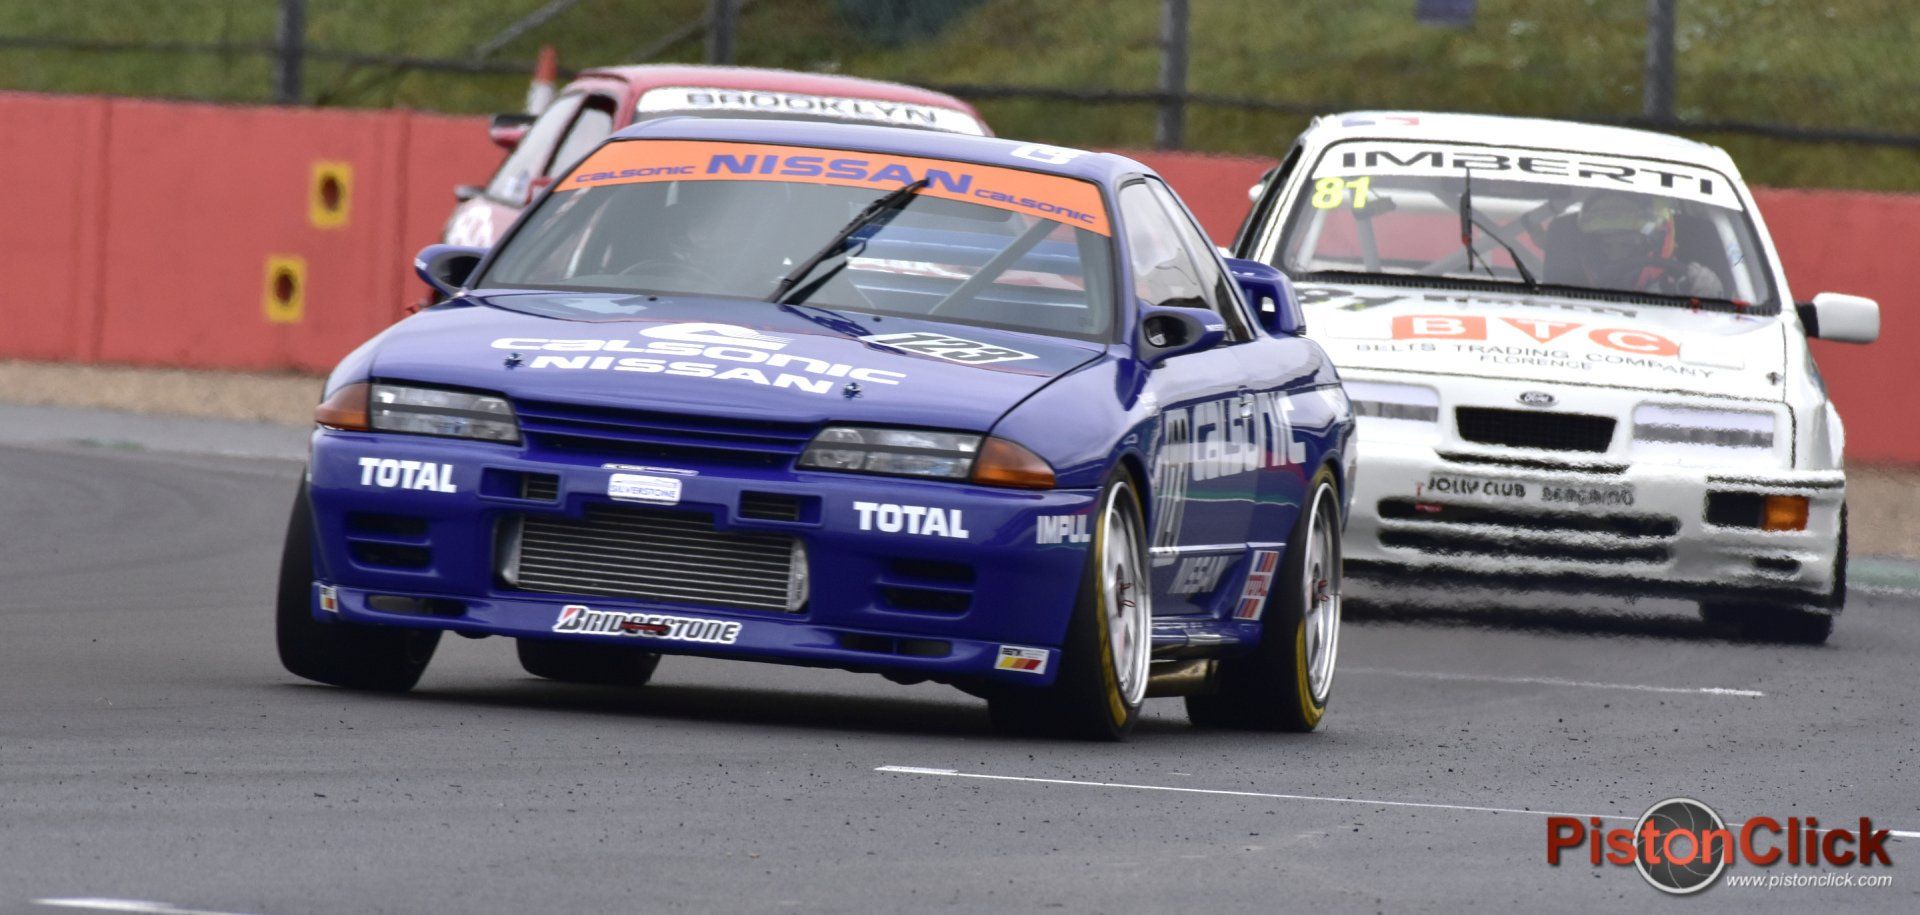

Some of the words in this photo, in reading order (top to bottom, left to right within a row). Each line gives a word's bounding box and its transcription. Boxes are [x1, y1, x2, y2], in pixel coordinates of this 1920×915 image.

[687, 93, 938, 123] BROOKLYN
[706, 154, 973, 195] NISSAN
[1342, 151, 1713, 196] IMBERTI
[1311, 175, 1371, 210] 81
[876, 334, 1024, 363] 123
[1455, 344, 1569, 359] TRADING
[1585, 353, 1714, 379] COMPANY
[1480, 354, 1593, 370] FLORENCE
[529, 354, 833, 394] NISSAN
[359, 457, 457, 493] TOTAL
[1428, 477, 1479, 494] JOLLY
[1483, 481, 1526, 497] CLUB
[853, 501, 969, 539] TOTAL
[1036, 514, 1091, 544] IMPUL
